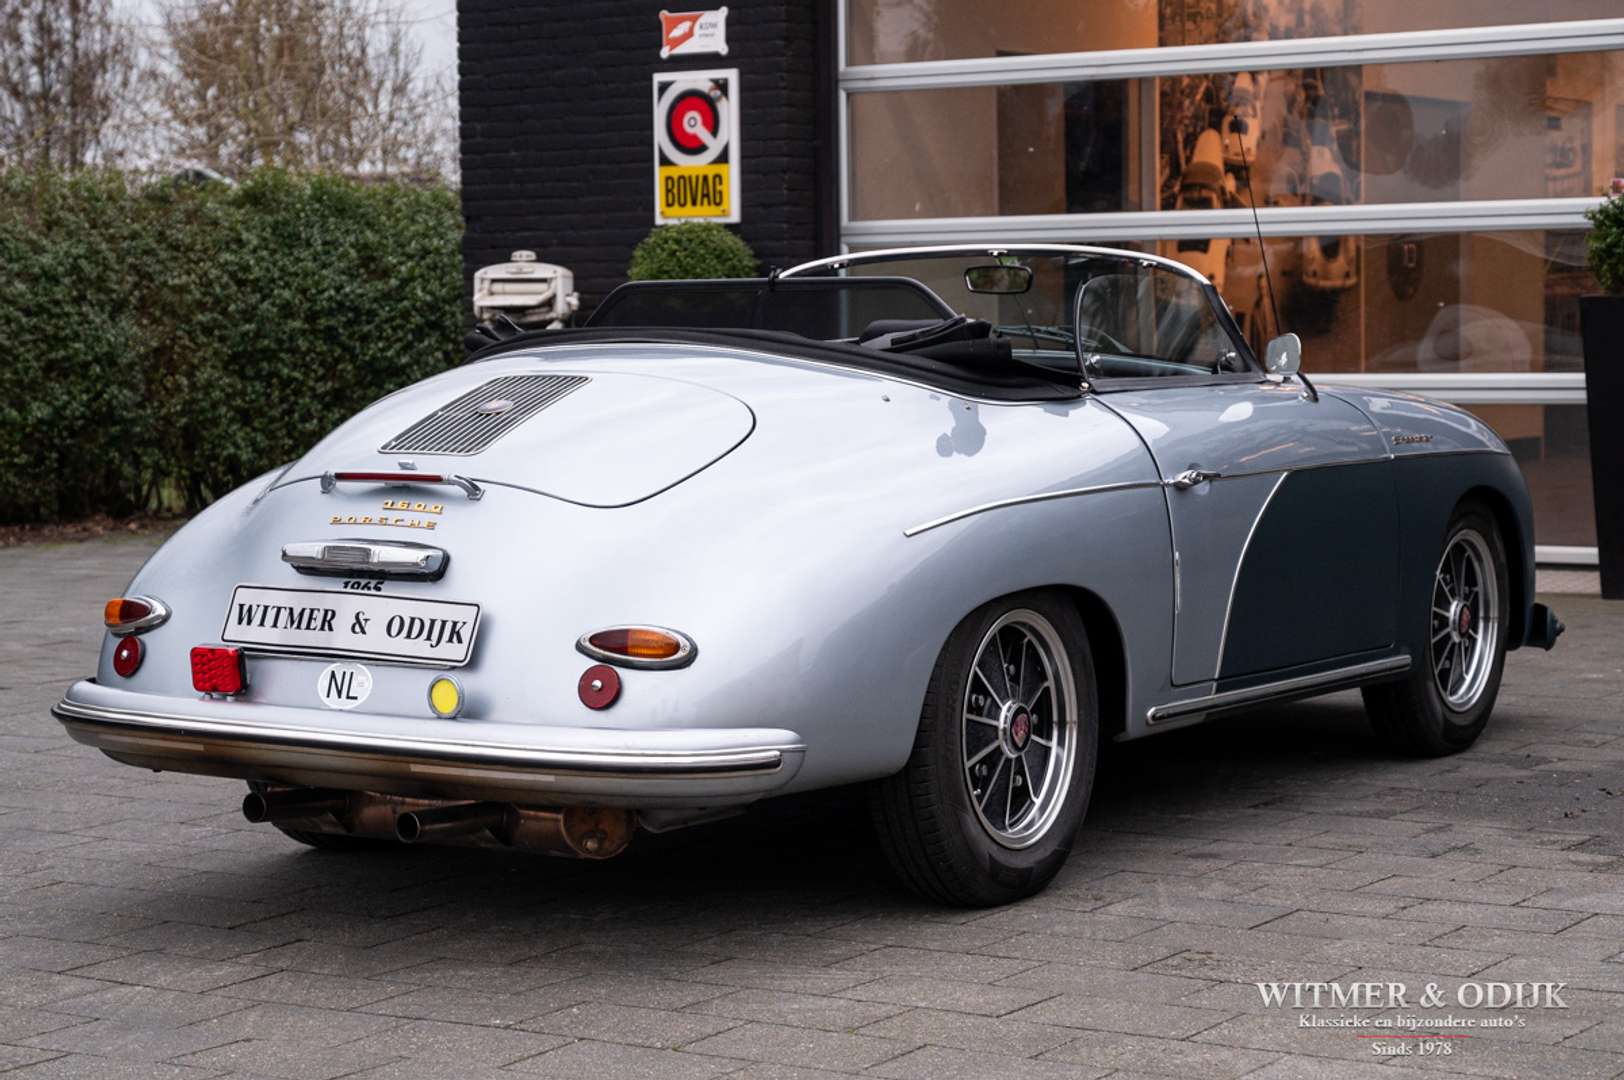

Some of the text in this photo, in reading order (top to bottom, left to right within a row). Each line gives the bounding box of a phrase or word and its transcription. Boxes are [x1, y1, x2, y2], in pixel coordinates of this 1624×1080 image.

[664, 174, 723, 208] BOVAG
[382, 499, 444, 515] 1600
[329, 515, 438, 530] PORSCHE
[237, 603, 468, 648] WITMER & ODIJK
[326, 670, 358, 700] NL
